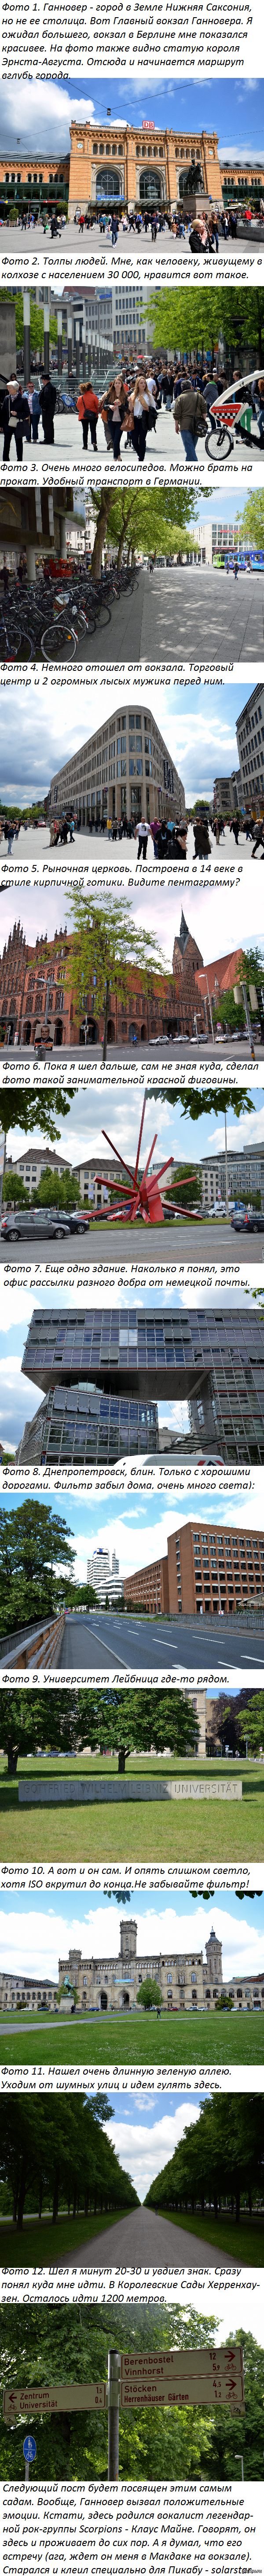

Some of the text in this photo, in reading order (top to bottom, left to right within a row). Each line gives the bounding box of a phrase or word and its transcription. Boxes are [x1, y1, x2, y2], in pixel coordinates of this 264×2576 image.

[23, 1782, 238, 1793] GOTTFRIED WILHELM LEIBNIZ UNIVERSITÄT
[124, 2355, 174, 2366] Berenbostel
[125, 2367, 164, 2376] Vinnhorst
[20, 2400, 58, 2409] Universität
